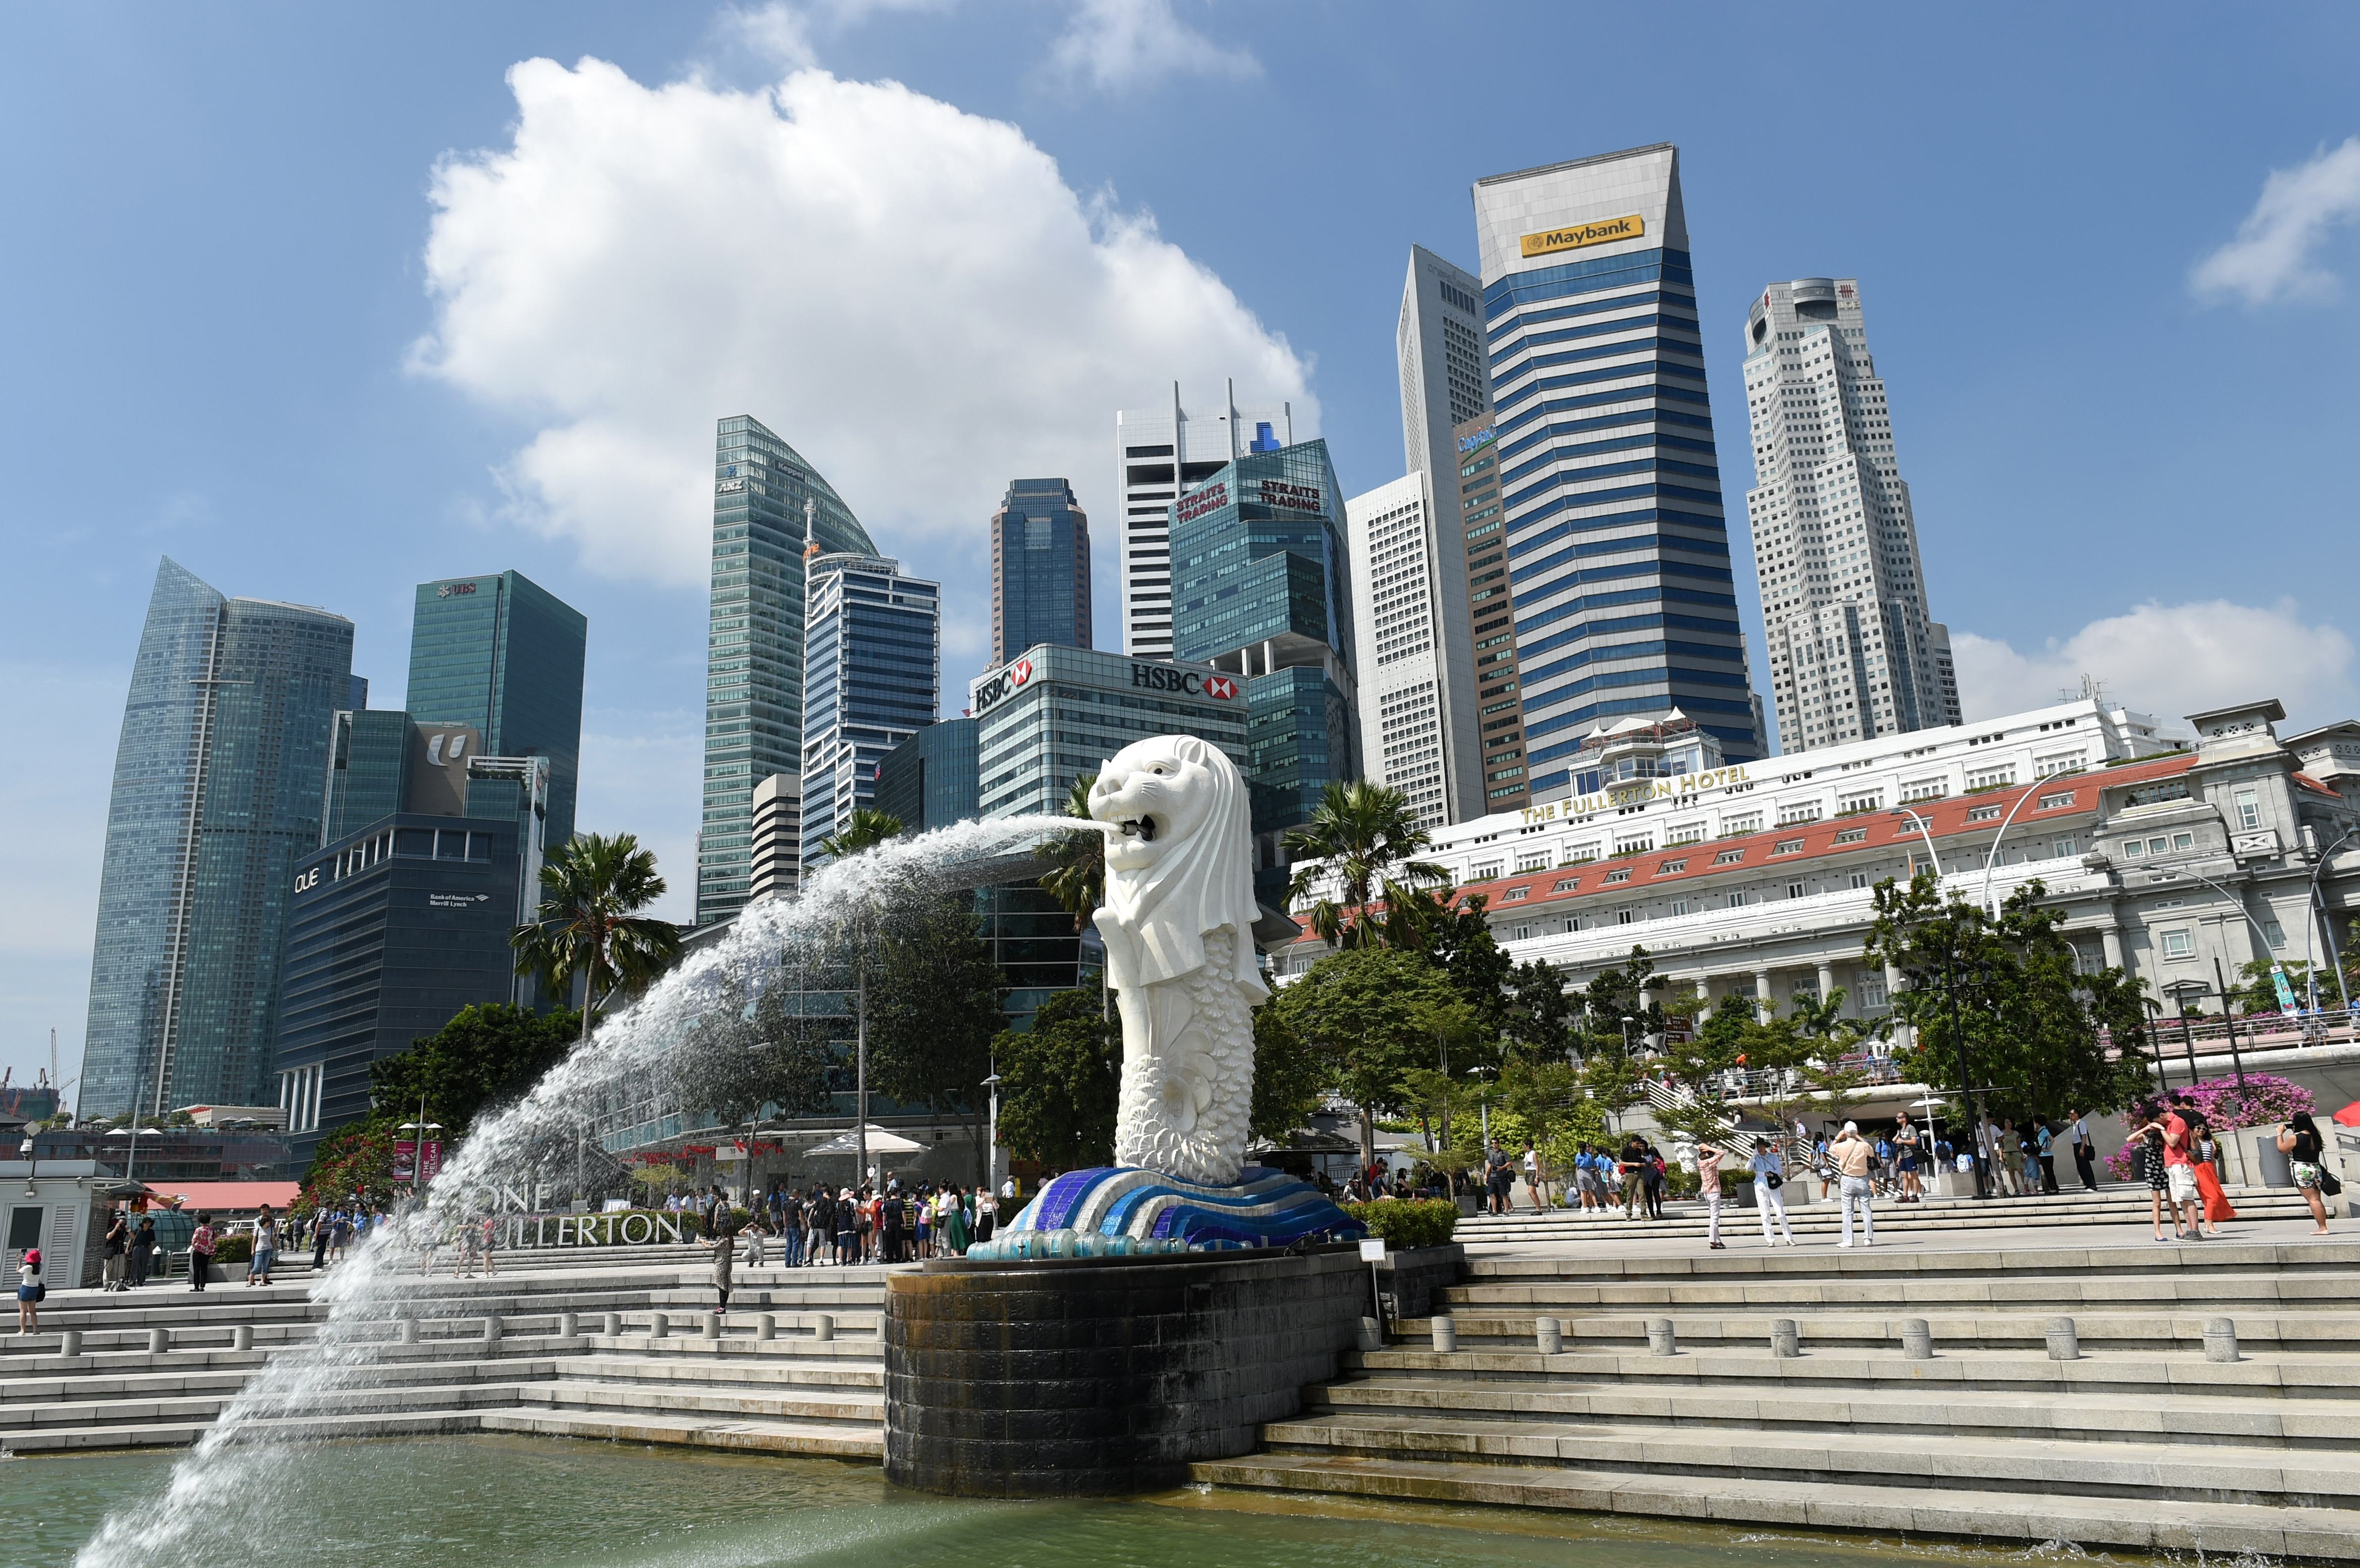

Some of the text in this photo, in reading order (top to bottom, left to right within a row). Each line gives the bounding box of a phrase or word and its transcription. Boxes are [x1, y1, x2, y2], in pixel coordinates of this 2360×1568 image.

[1546, 220, 1631, 246] Maybank
[1458, 424, 1497, 452] CapitaC
[778, 461, 804, 479] Keppel
[718, 481, 744, 492] ANZ
[1177, 483, 1225, 511] STRAITS
[1262, 480, 1320, 499] STRAITS
[1177, 494, 1228, 524] TRADING
[1259, 492, 1320, 512] TRADING
[452, 583, 476, 594] UBS
[975, 670, 1011, 711] HSBC
[1131, 663, 1200, 694] HSBC
[1521, 765, 1750, 824] THE FULLERTON HOTEL
[295, 868, 319, 893] OUE
[494, 1212, 684, 1249] ULLERTON
